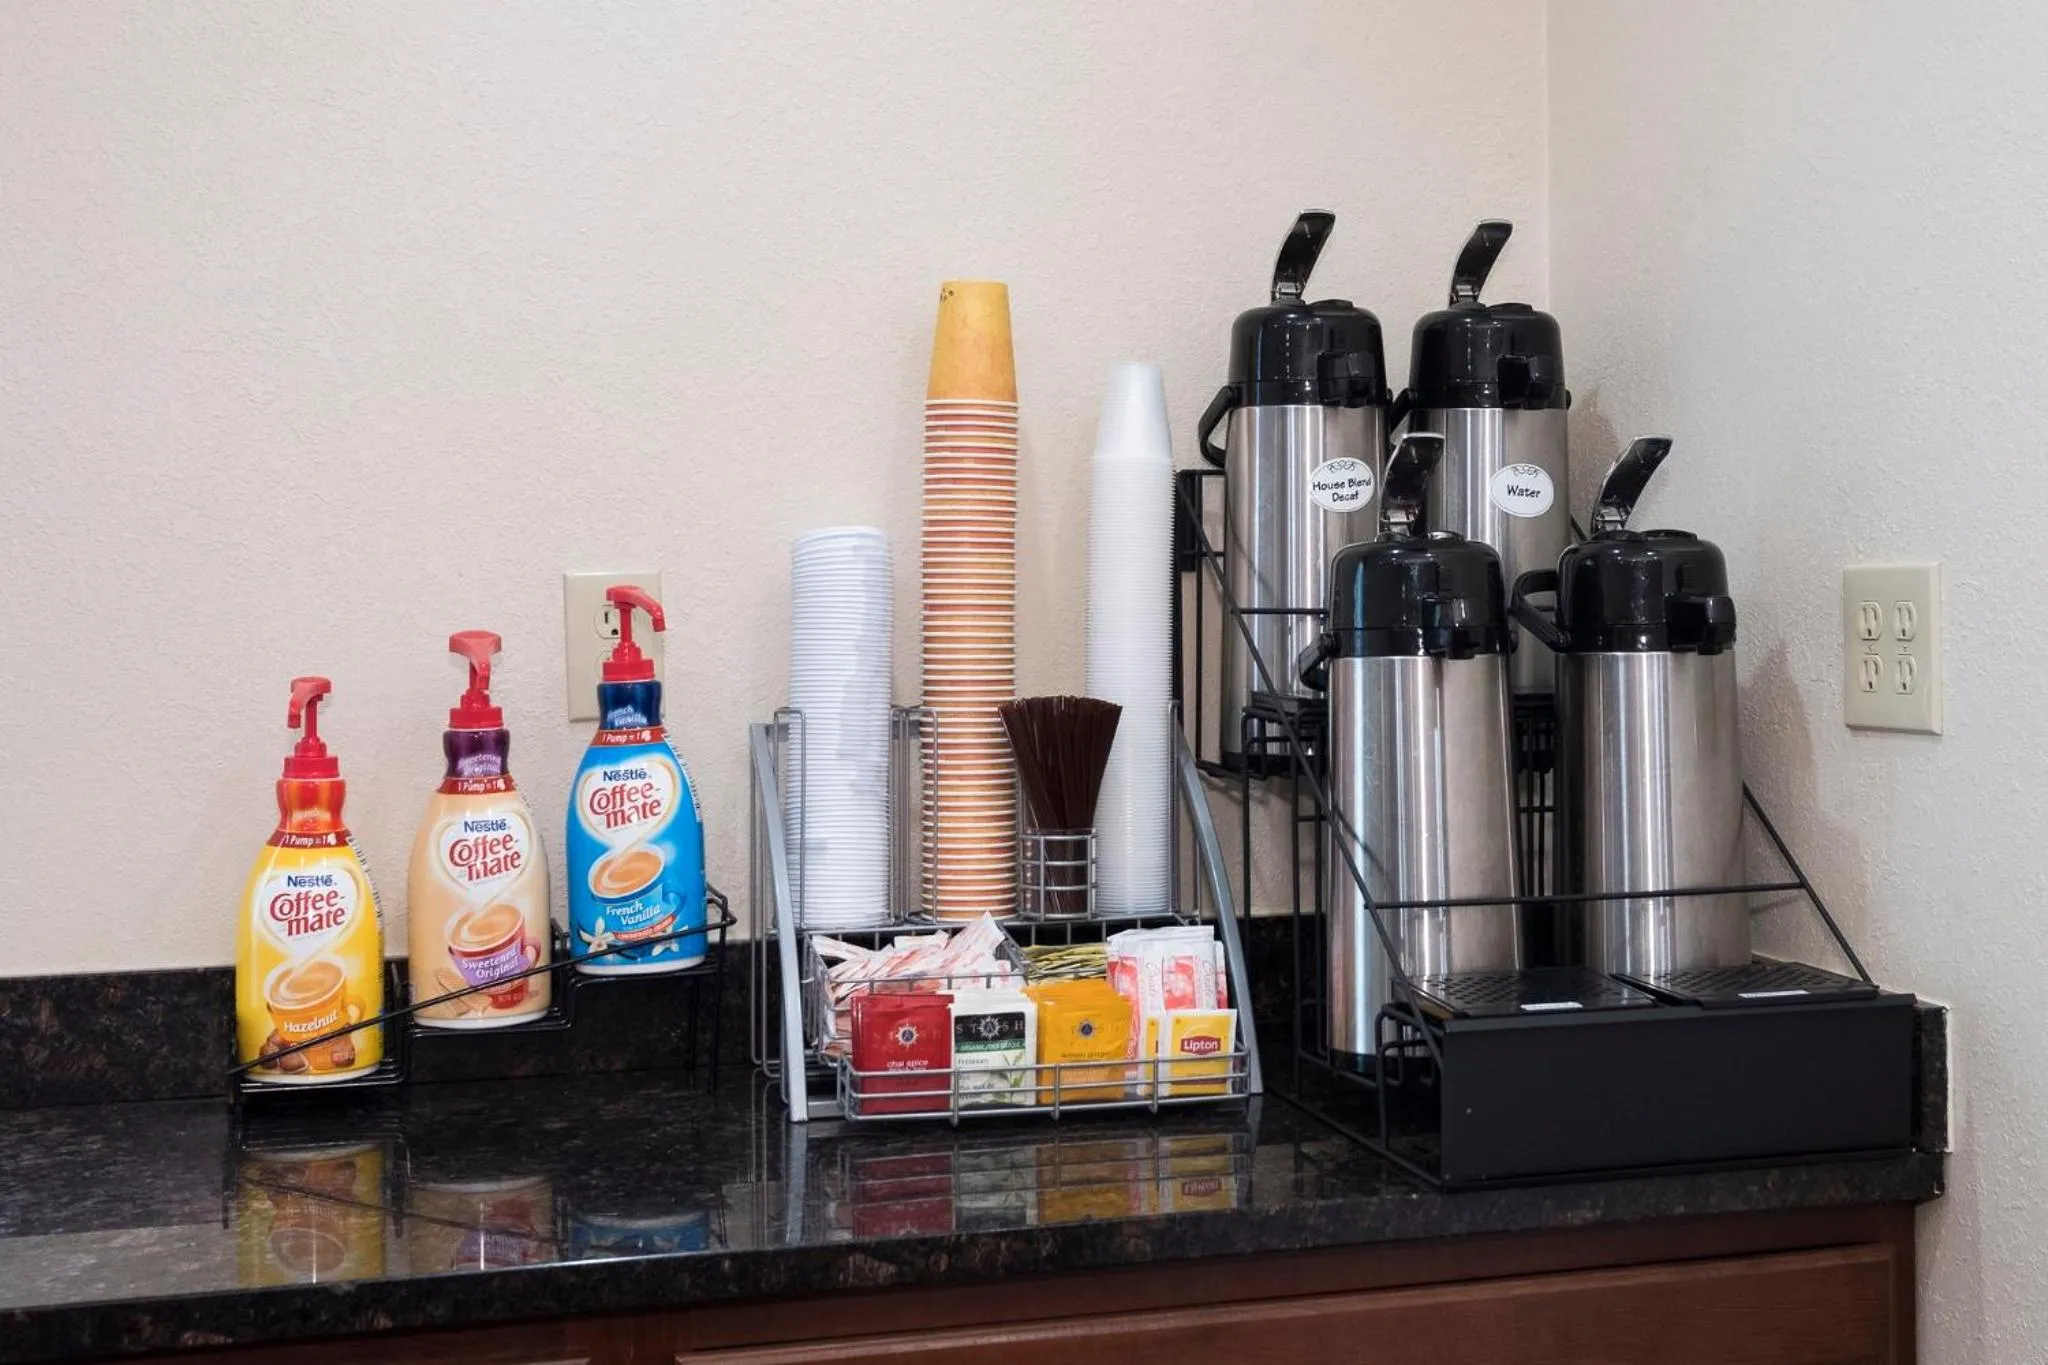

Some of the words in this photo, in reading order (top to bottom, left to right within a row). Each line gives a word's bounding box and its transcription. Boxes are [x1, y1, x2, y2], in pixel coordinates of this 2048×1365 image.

[1312, 481, 1345, 491] House
[1348, 477, 1372, 488] Blend
[1506, 484, 1541, 498] Water
[1332, 490, 1359, 502] Decaf
[603, 768, 648, 782] Nestlé
[463, 781, 486, 793] Pump
[605, 799, 662, 829] mate
[464, 819, 507, 833] Nestlé
[291, 834, 314, 847] Pump
[467, 851, 521, 880] mate
[287, 875, 333, 888] Nestlé
[606, 900, 643, 916] French
[620, 904, 661, 925] Vanilla
[287, 908, 345, 937] mate
[462, 946, 518, 969] Sweetened
[476, 957, 518, 978] Original
[284, 1009, 340, 1033] Hazelnut
[1184, 1039, 1219, 1052] Lipton
[887, 1060, 904, 1068] chai
[906, 1059, 929, 1068] spice
